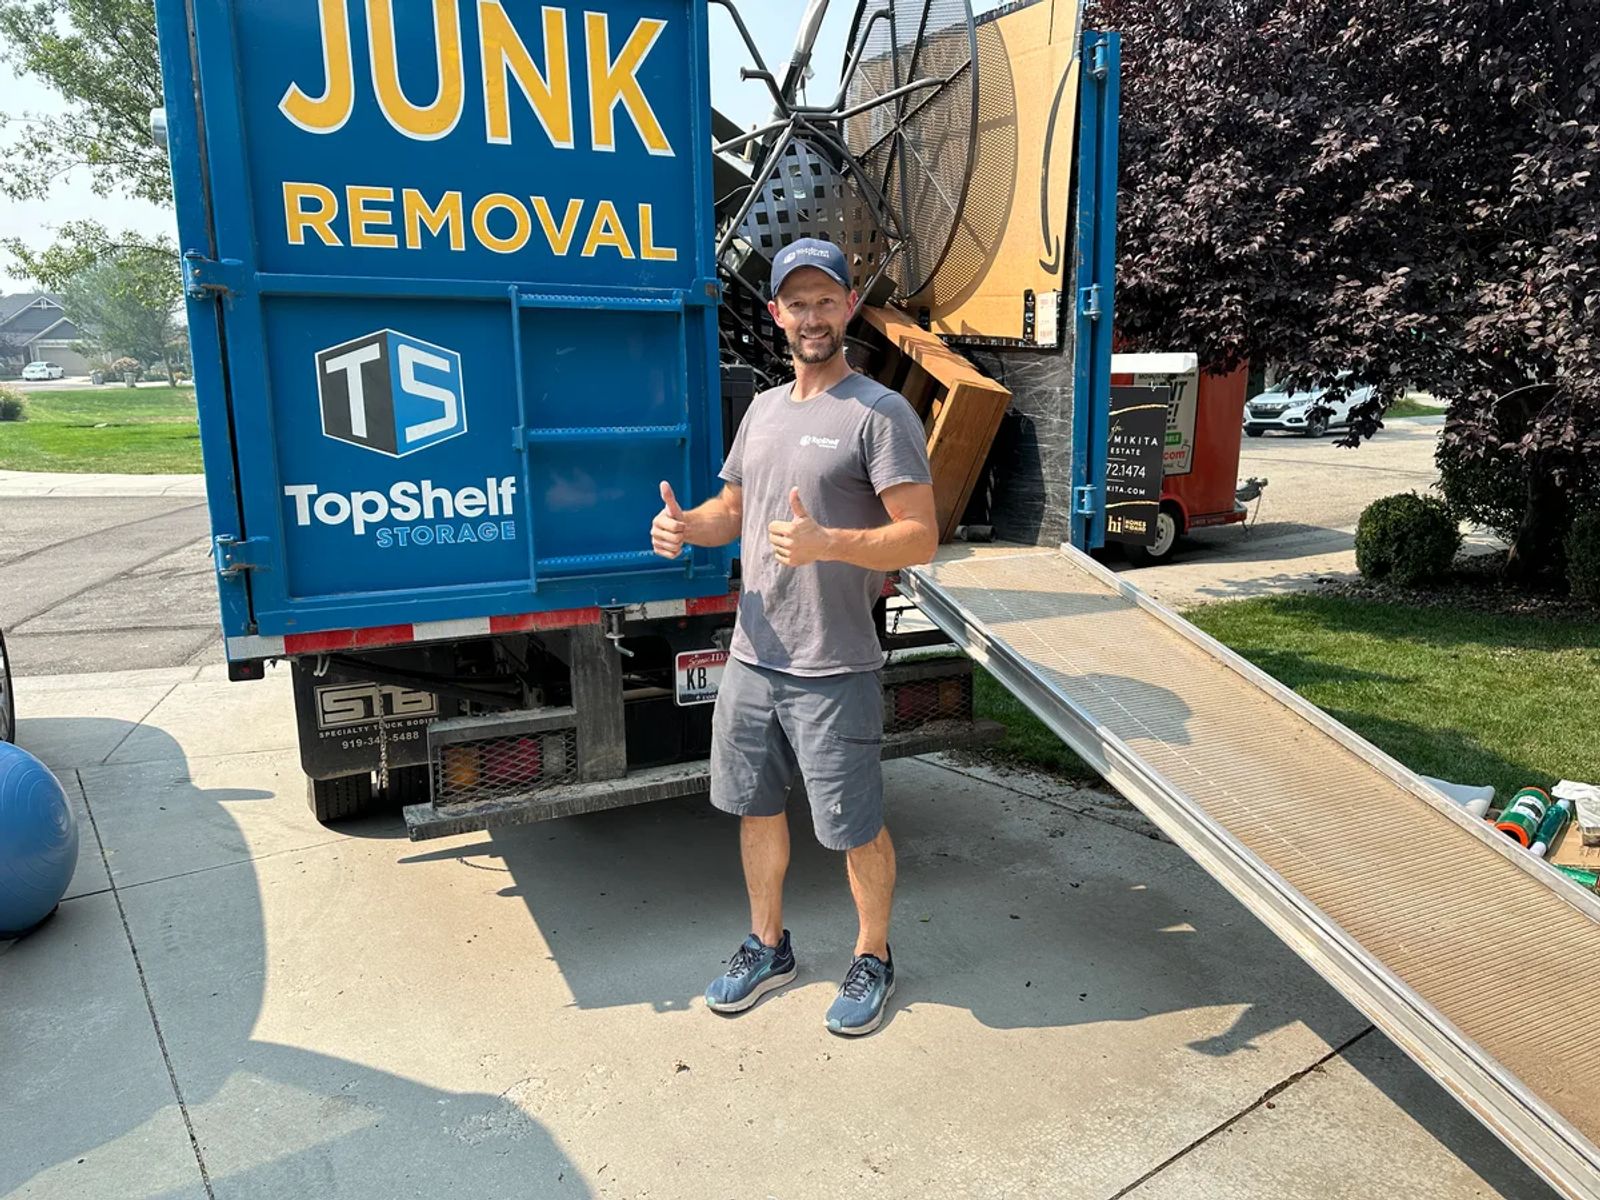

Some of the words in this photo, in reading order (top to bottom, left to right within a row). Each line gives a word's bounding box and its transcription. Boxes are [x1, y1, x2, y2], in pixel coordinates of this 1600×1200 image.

[278, 0, 676, 157] JUNK
[282, 181, 678, 261] REMOVAL
[325, 342, 458, 443] TS
[1110, 447, 1141, 456] ESTATE
[1114, 435, 1158, 446] MIKITA
[284, 476, 517, 535] TopShelf
[376, 521, 516, 548] STORAGE
[1107, 515, 1122, 533] hi
[686, 667, 707, 690] KB
[319, 725, 369, 739] SPECIALTY
[373, 721, 403, 730] TUCK
[342, 731, 419, 750] 919-34-5488
